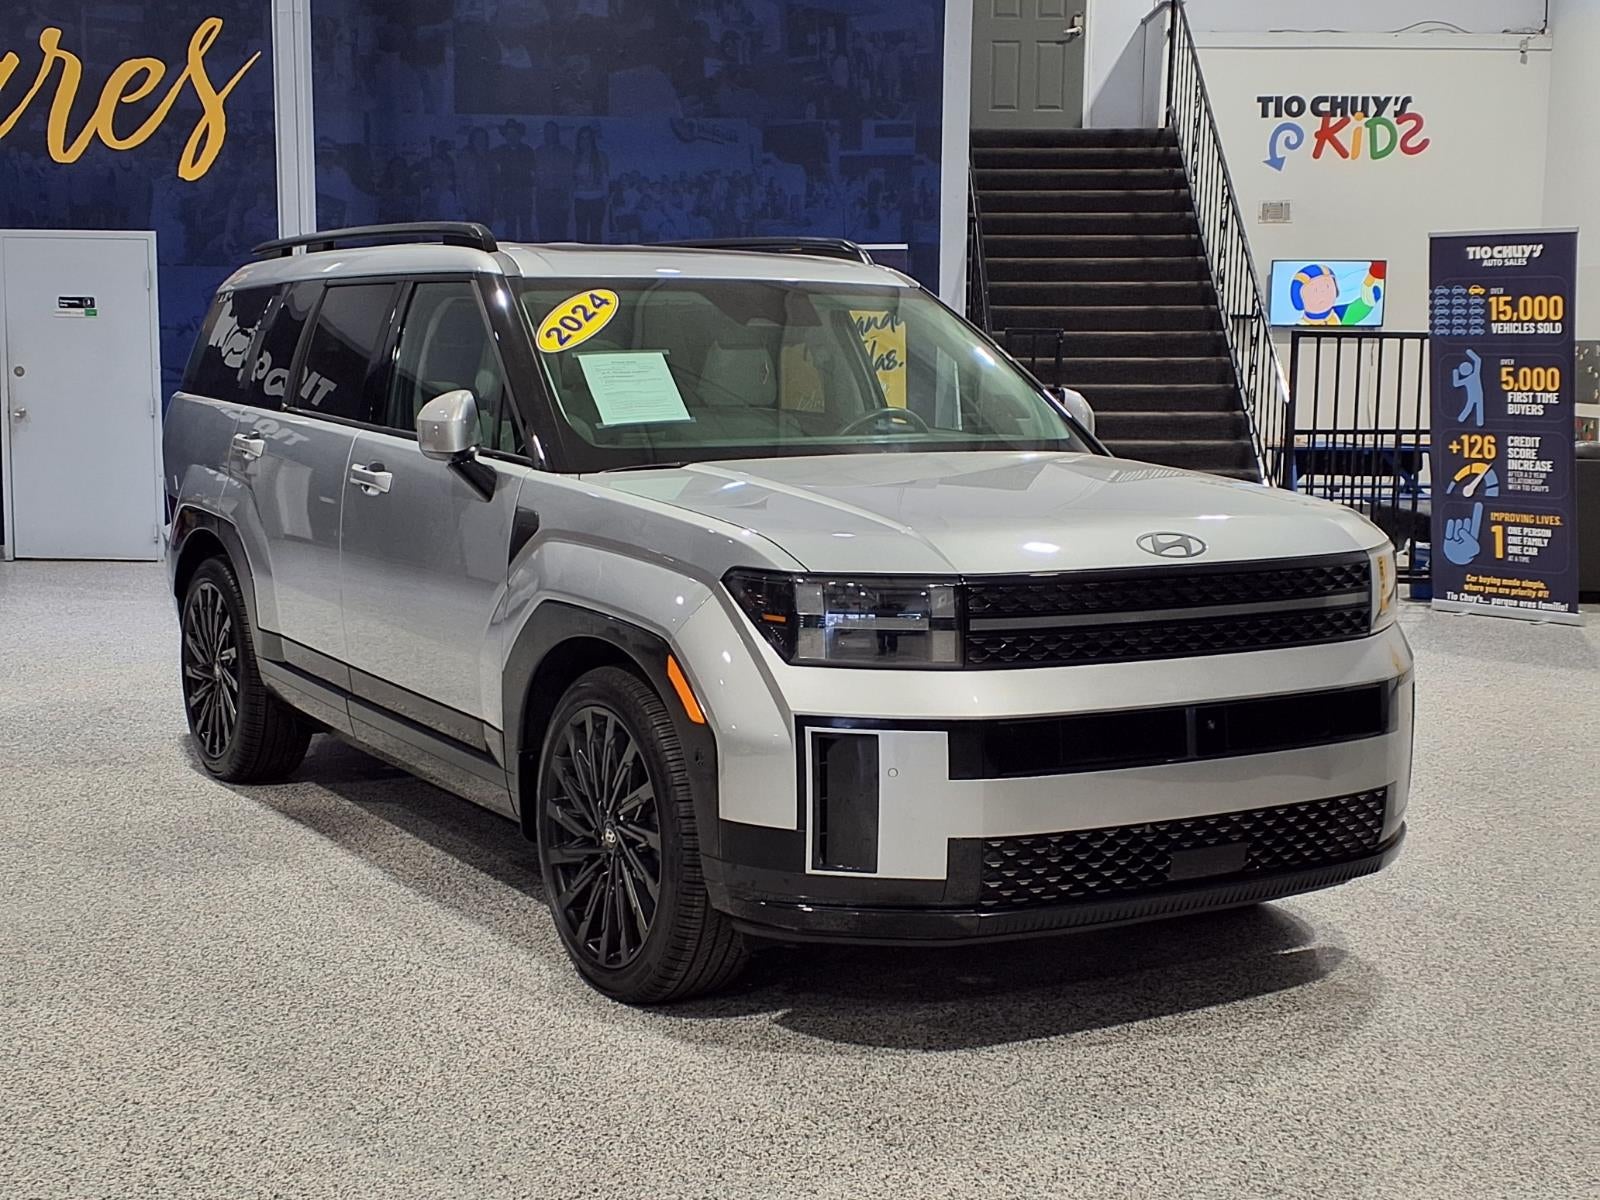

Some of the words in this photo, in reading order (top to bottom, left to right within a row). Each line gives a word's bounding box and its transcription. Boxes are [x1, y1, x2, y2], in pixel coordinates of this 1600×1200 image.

[1257, 96, 1306, 118] TIO
[1310, 96, 1412, 119] CHUY'S
[1466, 246, 1491, 259] TIO
[1492, 244, 1543, 258] CHUY'S
[1482, 259, 1502, 267] AUTO
[1504, 258, 1527, 266] SALES
[1488, 295, 1563, 321] 15,000
[545, 293, 611, 346] 2024
[1491, 323, 1535, 334] VEHICLES
[1536, 322, 1562, 334] SOLD
[1501, 367, 1560, 391] 5,000
[1507, 392, 1534, 403] FIRST
[1535, 393, 1559, 404] TIME
[1507, 404, 1544, 415] BUYERS
[1448, 434, 1496, 459] +126
[1507, 436, 1541, 447] CREDIT
[1507, 448, 1538, 459] SCORE
[1508, 460, 1554, 472] INCREASE
[1490, 511, 1535, 523] IMPROVING
[1507, 526, 1523, 536] ONE
[1523, 527, 1552, 537] PERSON
[1491, 525, 1504, 559] 1
[1507, 536, 1523, 546] ONE
[1523, 536, 1549, 547] FAMILY
[1507, 545, 1523, 555] ONE
[1523, 545, 1538, 556] CAR
[1465, 574, 1478, 582] Car
[1478, 575, 1501, 586] buying
[1501, 578, 1521, 586] made
[1464, 582, 1484, 592] where
[1485, 585, 1498, 594] you
[1499, 586, 1510, 594] are
[1510, 587, 1537, 598] priority
[1447, 591, 1458, 600] Tio
[1491, 597, 1518, 608] porque
[1538, 601, 1569, 612] familia!
